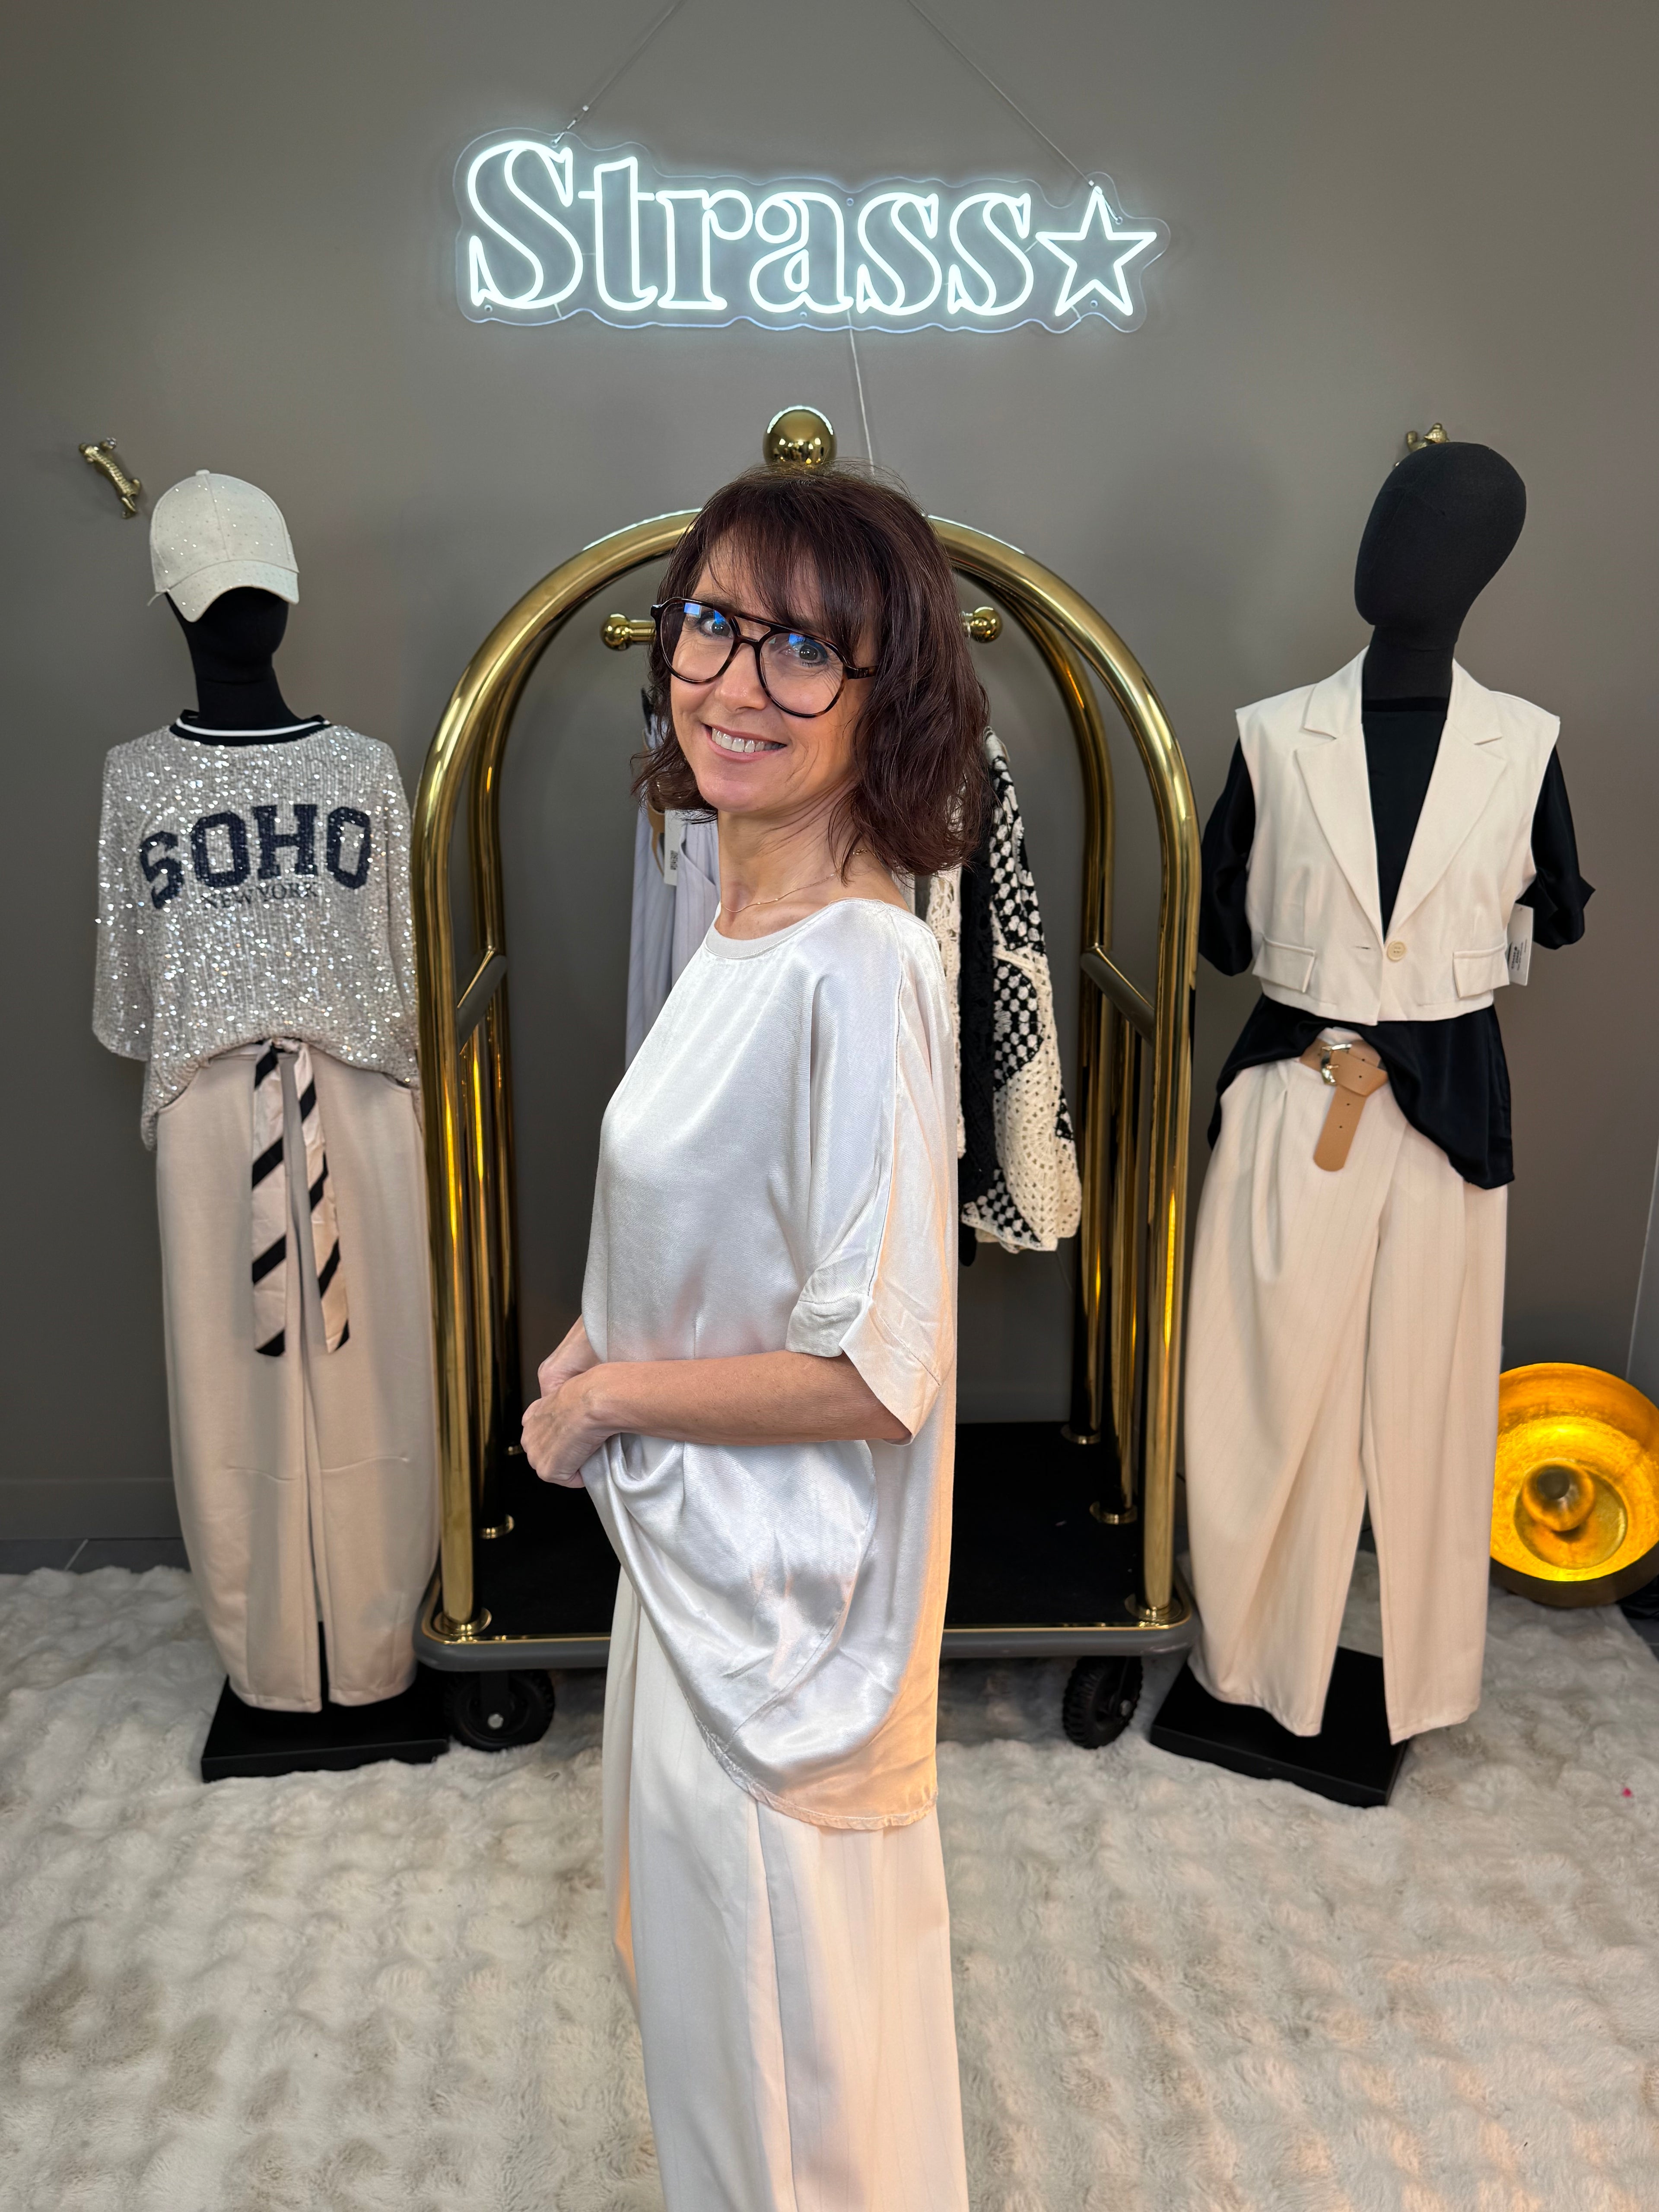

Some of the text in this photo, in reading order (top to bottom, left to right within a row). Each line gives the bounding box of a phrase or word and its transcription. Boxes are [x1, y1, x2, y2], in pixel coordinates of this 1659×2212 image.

[467, 140, 1034, 316] Strass
[139, 804, 372, 909] SOHO
[201, 881, 319, 909] NEW YORK
